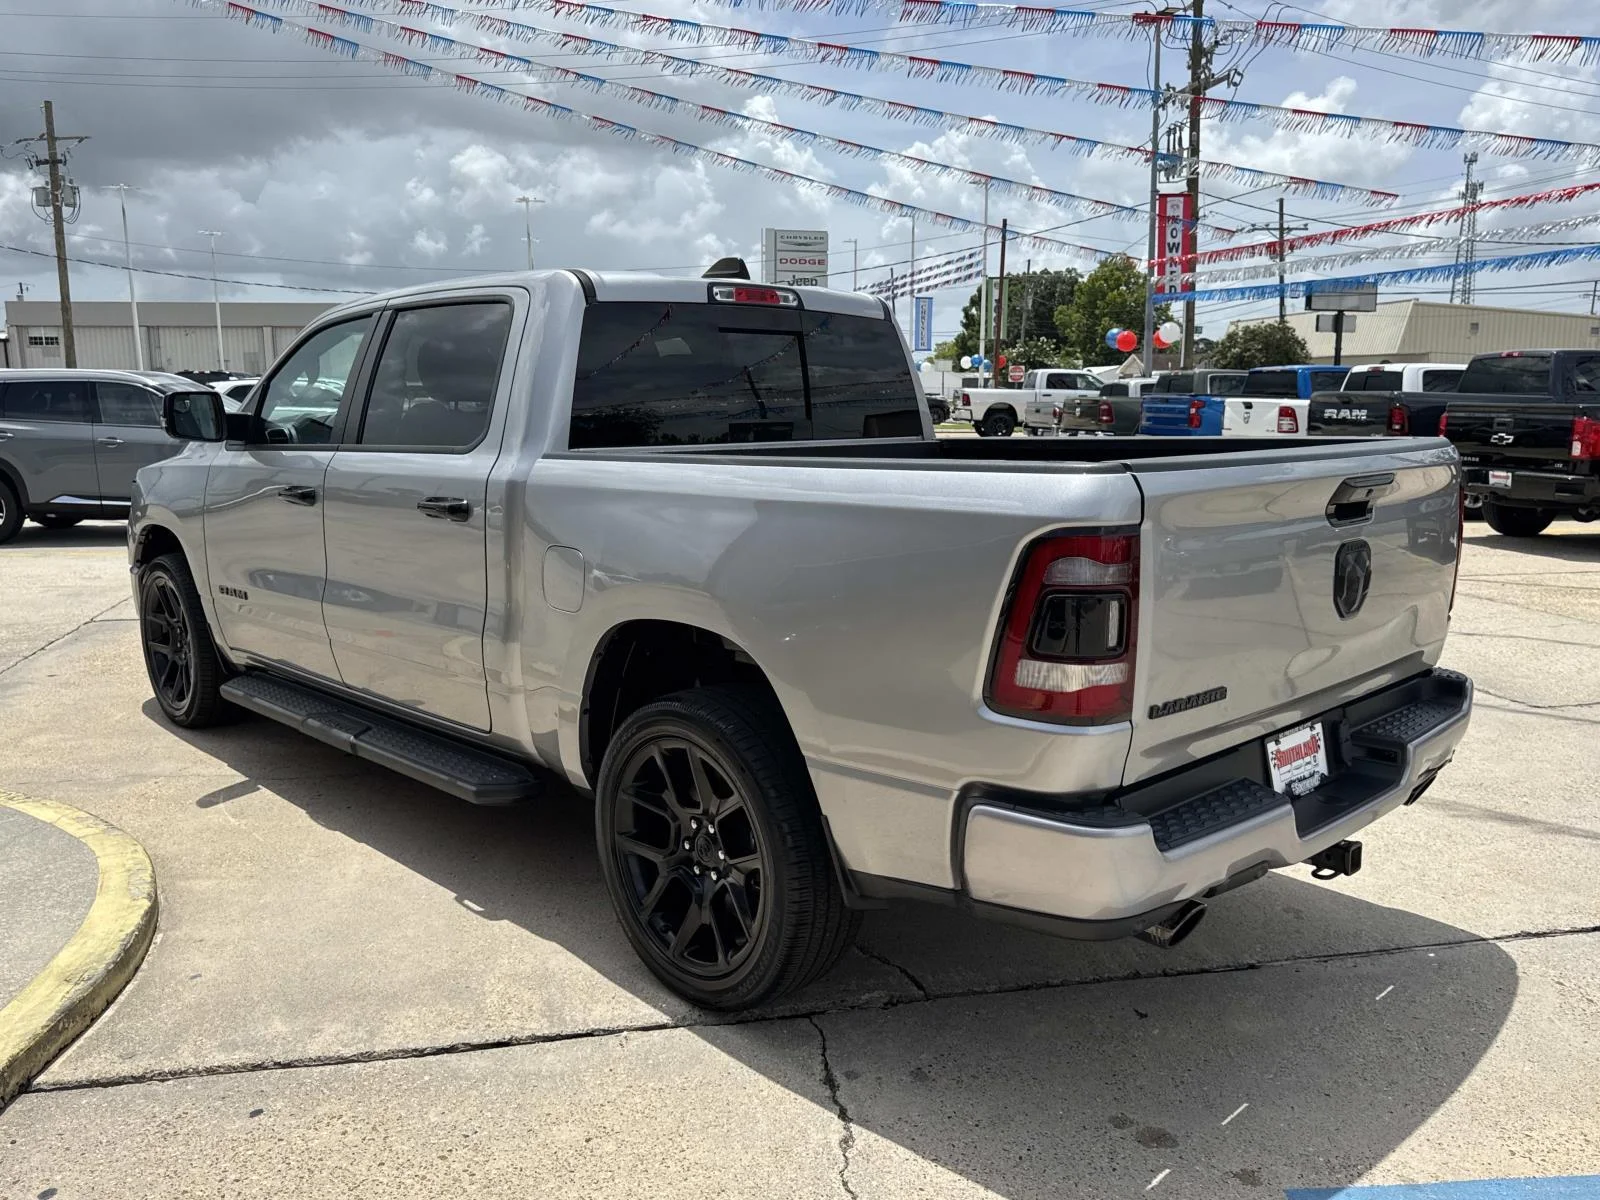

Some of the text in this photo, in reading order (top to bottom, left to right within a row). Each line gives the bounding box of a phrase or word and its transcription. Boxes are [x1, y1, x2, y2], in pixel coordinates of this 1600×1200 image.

[787, 274, 818, 287] Jeep
[1323, 409, 1367, 420] RAM
[1274, 735, 1320, 769] SOUTHLAND
